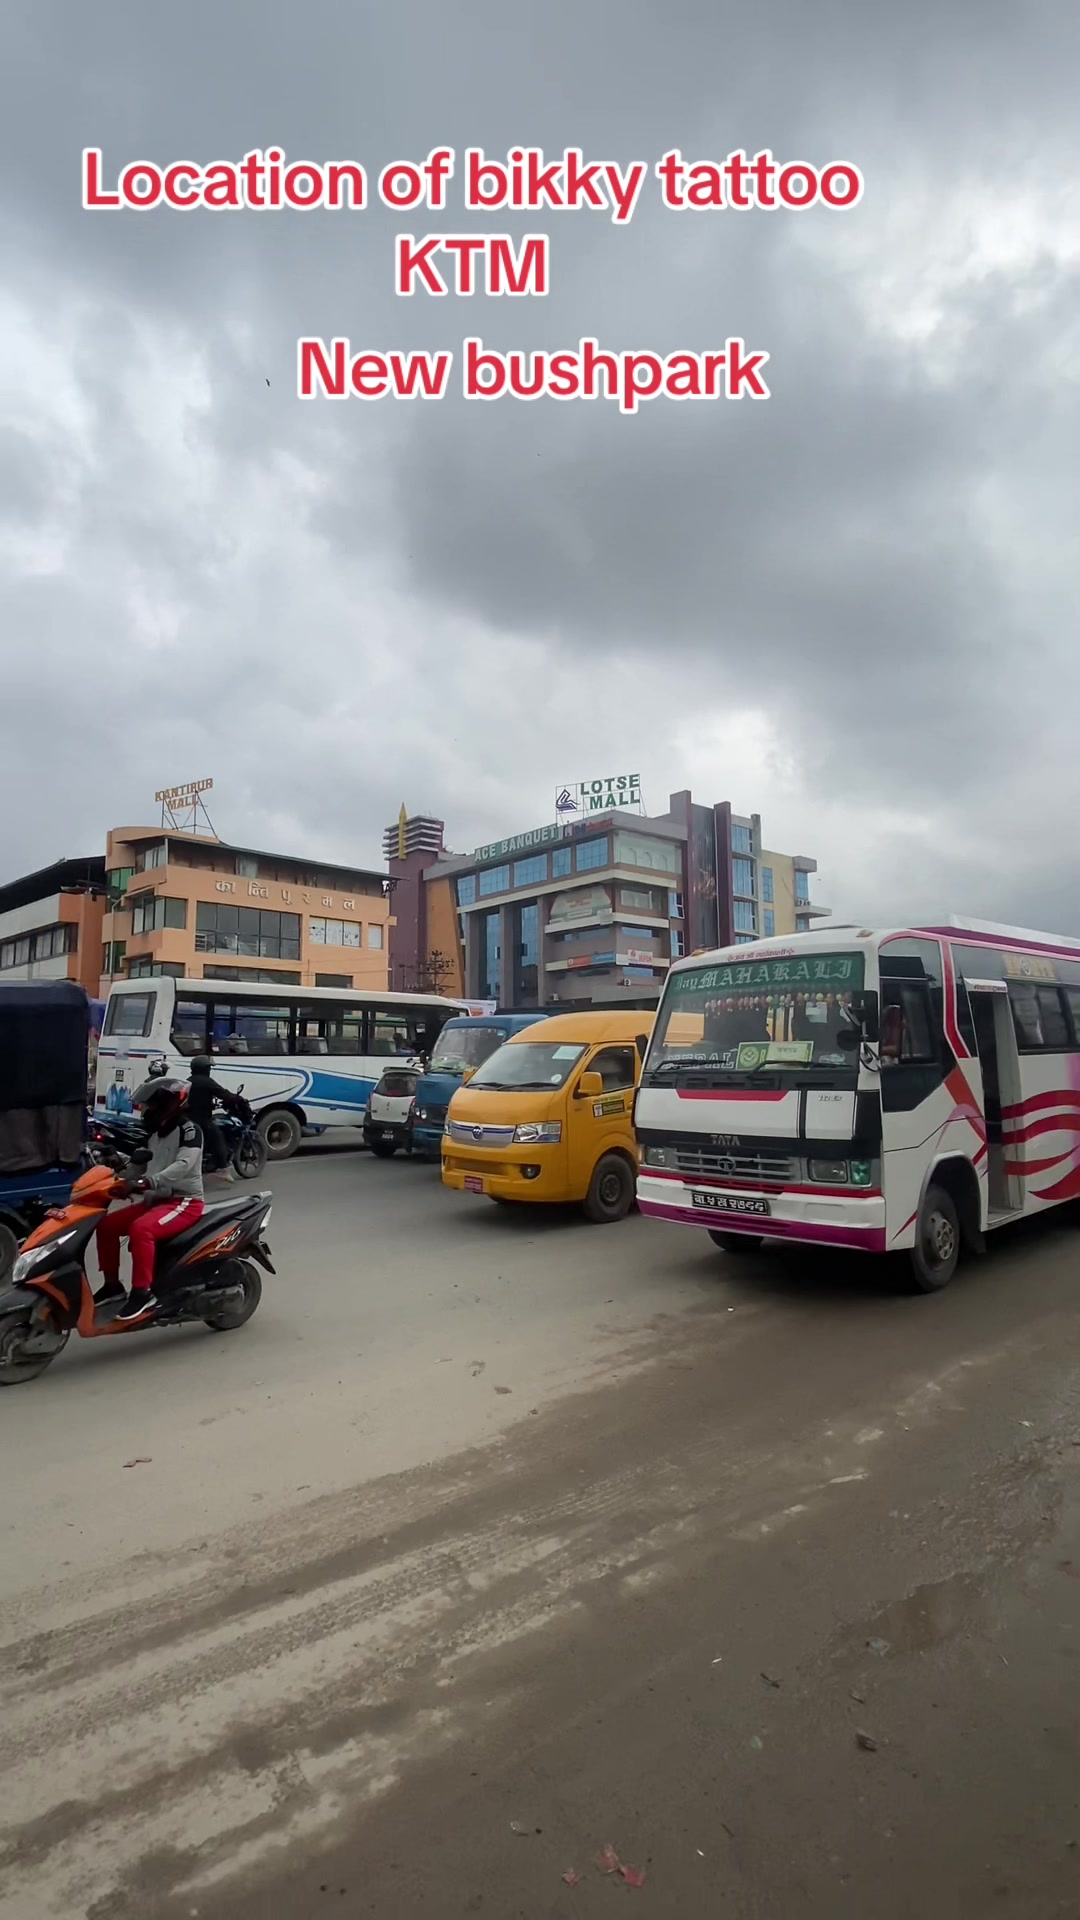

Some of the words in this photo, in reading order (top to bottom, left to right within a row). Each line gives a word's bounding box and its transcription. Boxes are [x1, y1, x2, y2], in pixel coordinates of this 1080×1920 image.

[580, 774, 640, 795] LOTSE
[590, 790, 640, 809] MALL
[501, 826, 557, 853] BANQUET
[698, 960, 852, 989] MAHAKALI
[710, 1134, 740, 1146] TATA
